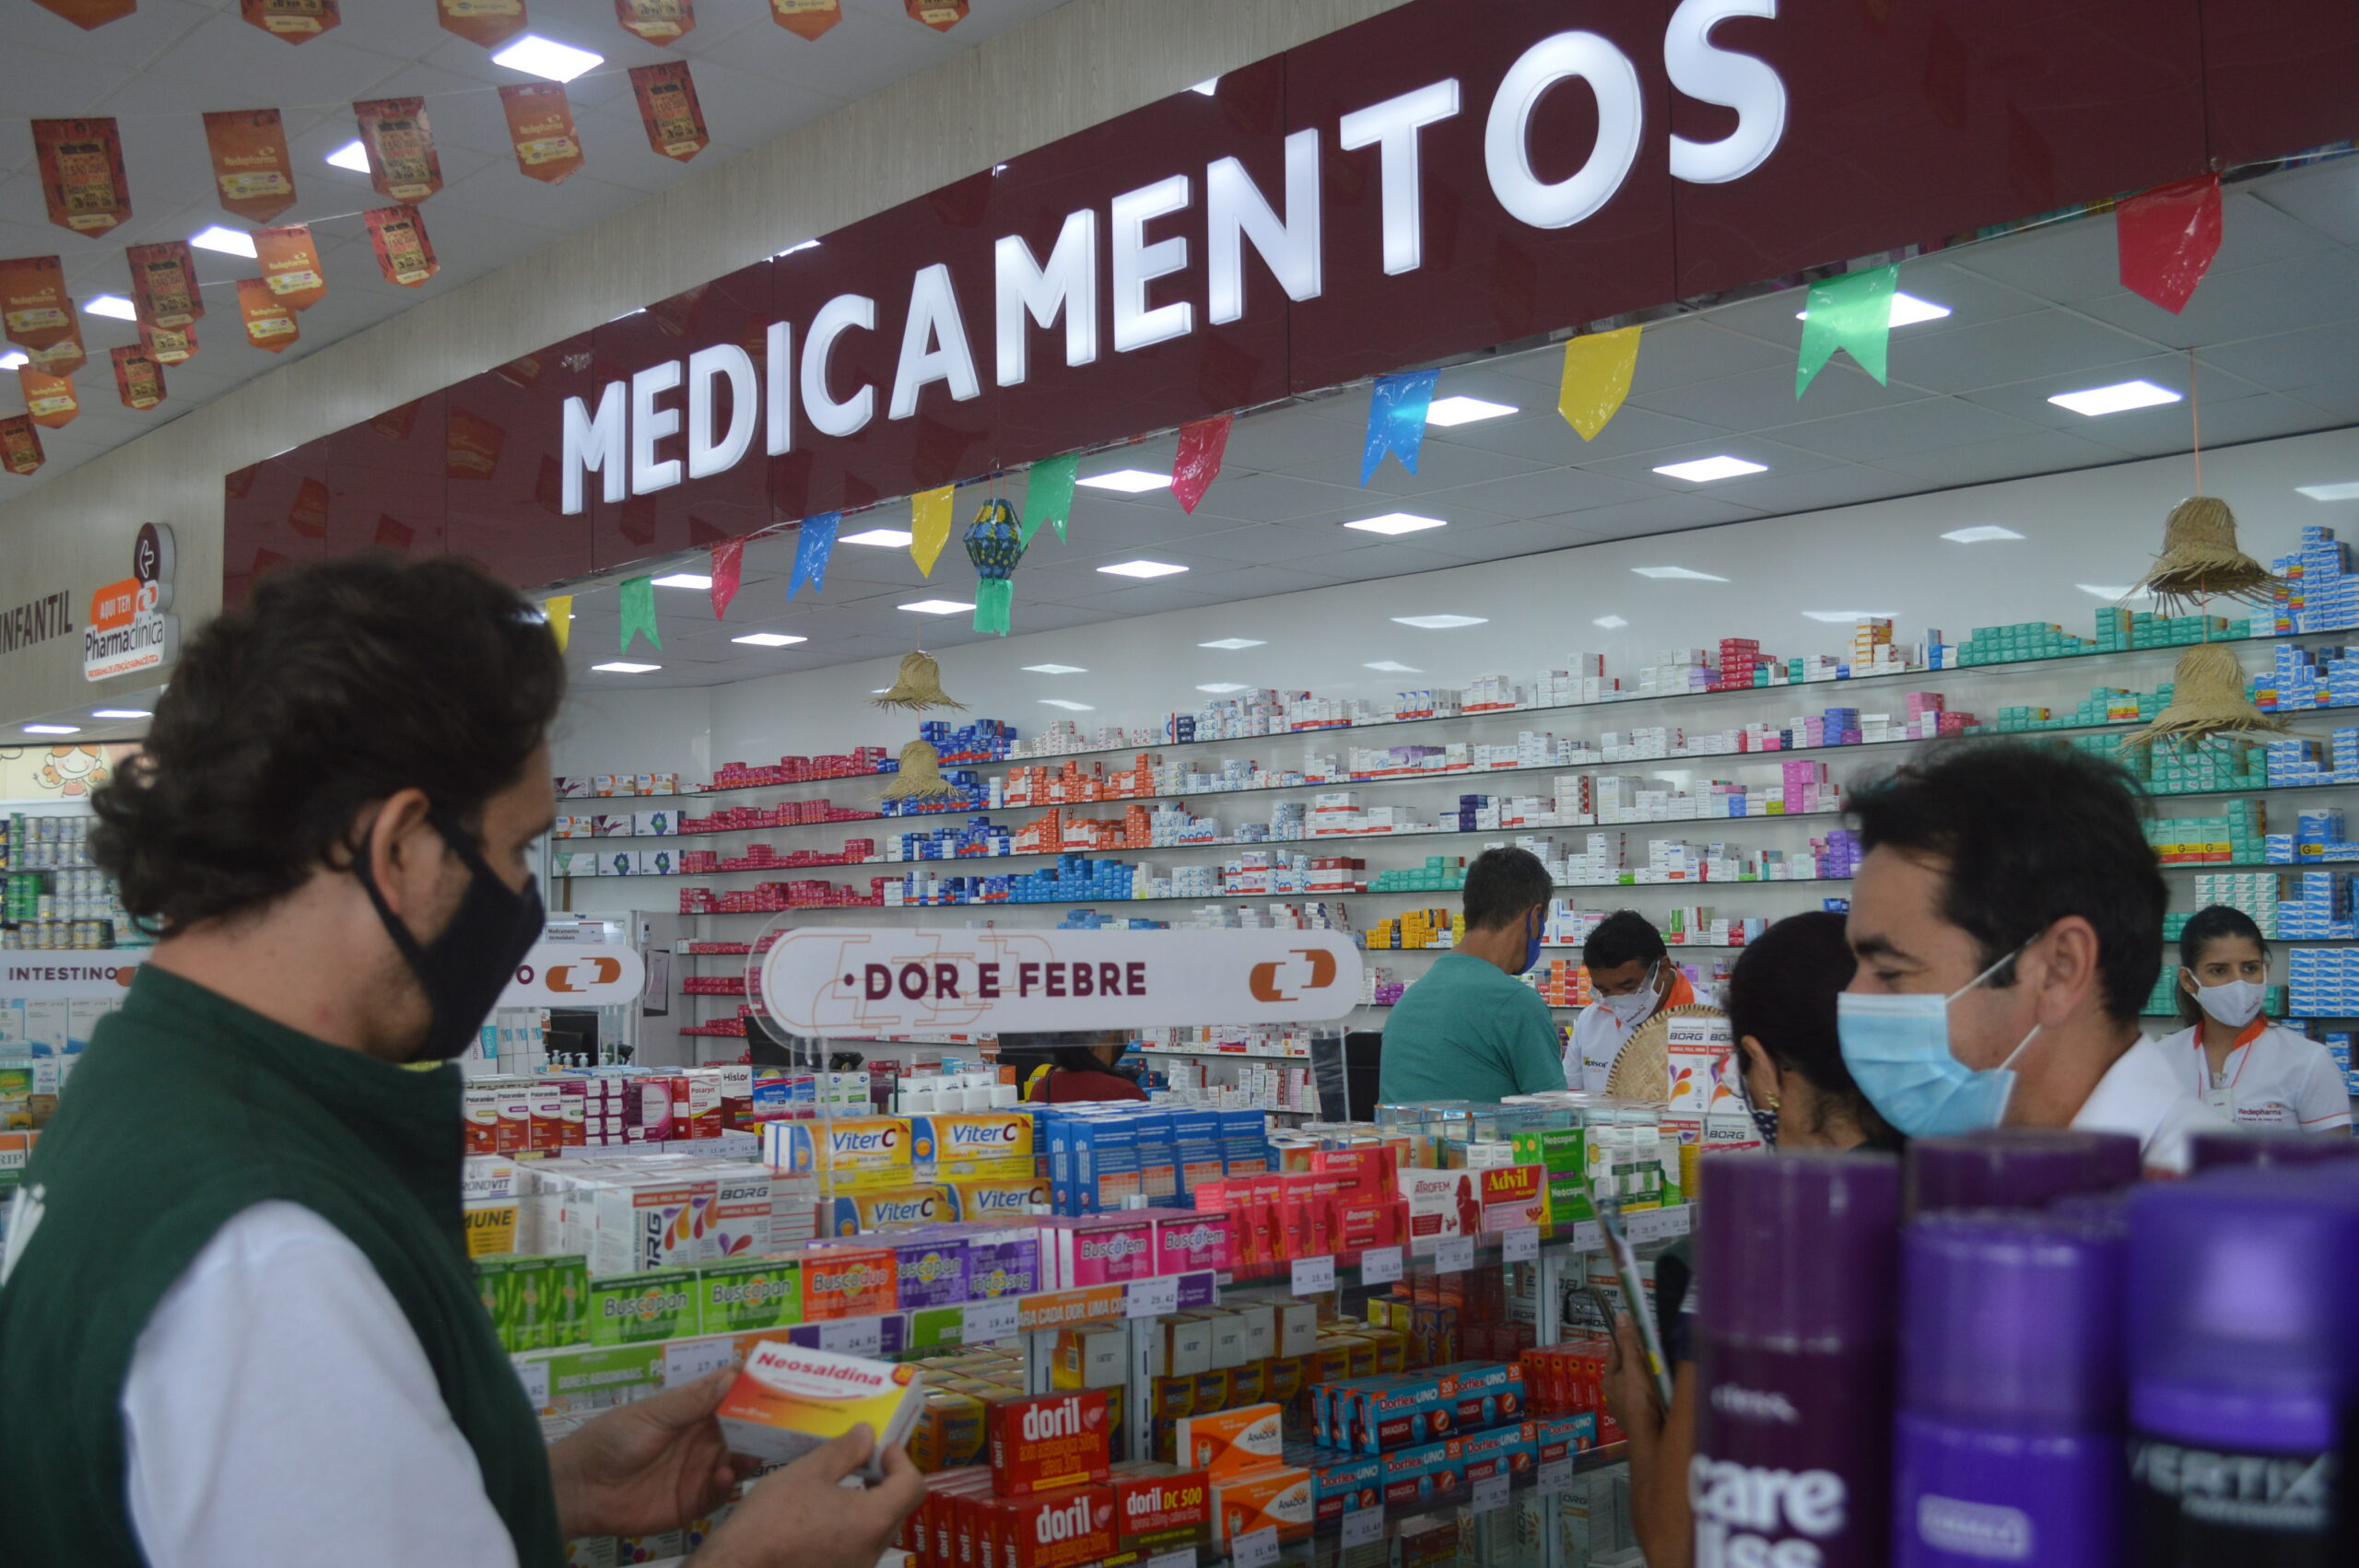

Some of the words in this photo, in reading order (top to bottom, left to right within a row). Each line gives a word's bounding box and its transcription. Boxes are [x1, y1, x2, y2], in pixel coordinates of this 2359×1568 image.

[560, 0, 1788, 515] MEDICAMENTOS
[100, 598, 116, 620] AQUI
[117, 593, 131, 614] TEM
[85, 615, 163, 662] Pharmaclínica
[9, 966, 118, 981] INTESTINO
[864, 961, 959, 1002] DOR
[980, 963, 1001, 999] E
[1019, 960, 1148, 998] FEBRE
[1669, 1032, 1704, 1041] BORG
[690, 1086, 716, 1095] Polaryn
[723, 1072, 749, 1082] Hislor
[2237, 1107, 2283, 1117] Redepharma
[1543, 1133, 1578, 1145] Neocopan
[1709, 1129, 1747, 1140] BORG
[1487, 1166, 1529, 1192] Advil
[720, 1186, 769, 1200] BORG
[465, 1209, 514, 1228] MUNE
[1081, 1237, 1147, 1259] Buscofem
[1165, 1228, 1226, 1250] Buscofem
[711, 1279, 792, 1305] Buscopan
[812, 1265, 889, 1293] Buscoduo
[604, 1291, 689, 1318] Buscopan
[1017, 1309, 1036, 1328] ARA
[756, 1351, 884, 1387] Neosaldina
[1485, 1372, 1507, 1386] UNO
[1509, 1364, 1520, 1377] 20
[1379, 1395, 1415, 1410] Dorflex
[1415, 1388, 1438, 1404] UNO
[1441, 1382, 1453, 1394] 20
[1023, 1396, 1082, 1441] doril
[1467, 1439, 1500, 1454] Dorflex
[1500, 1432, 1520, 1447] UNO
[1522, 1424, 1534, 1436] 20
[992, 1440, 1003, 1469] doril
[1387, 1456, 1424, 1473] Dorflex
[1424, 1448, 1446, 1465] UNO
[1449, 1442, 1461, 1453] 20
[1320, 1471, 1356, 1488] Dorflex
[1356, 1464, 1379, 1480] UNO
[1126, 1486, 1163, 1516] doril
[1163, 1490, 1179, 1510] DC
[1180, 1486, 1203, 1508] 500
[1035, 1494, 1091, 1544] doril
[914, 1524, 925, 1552] doril
[938, 1530, 949, 1558] doril
[959, 1533, 970, 1562] doril
